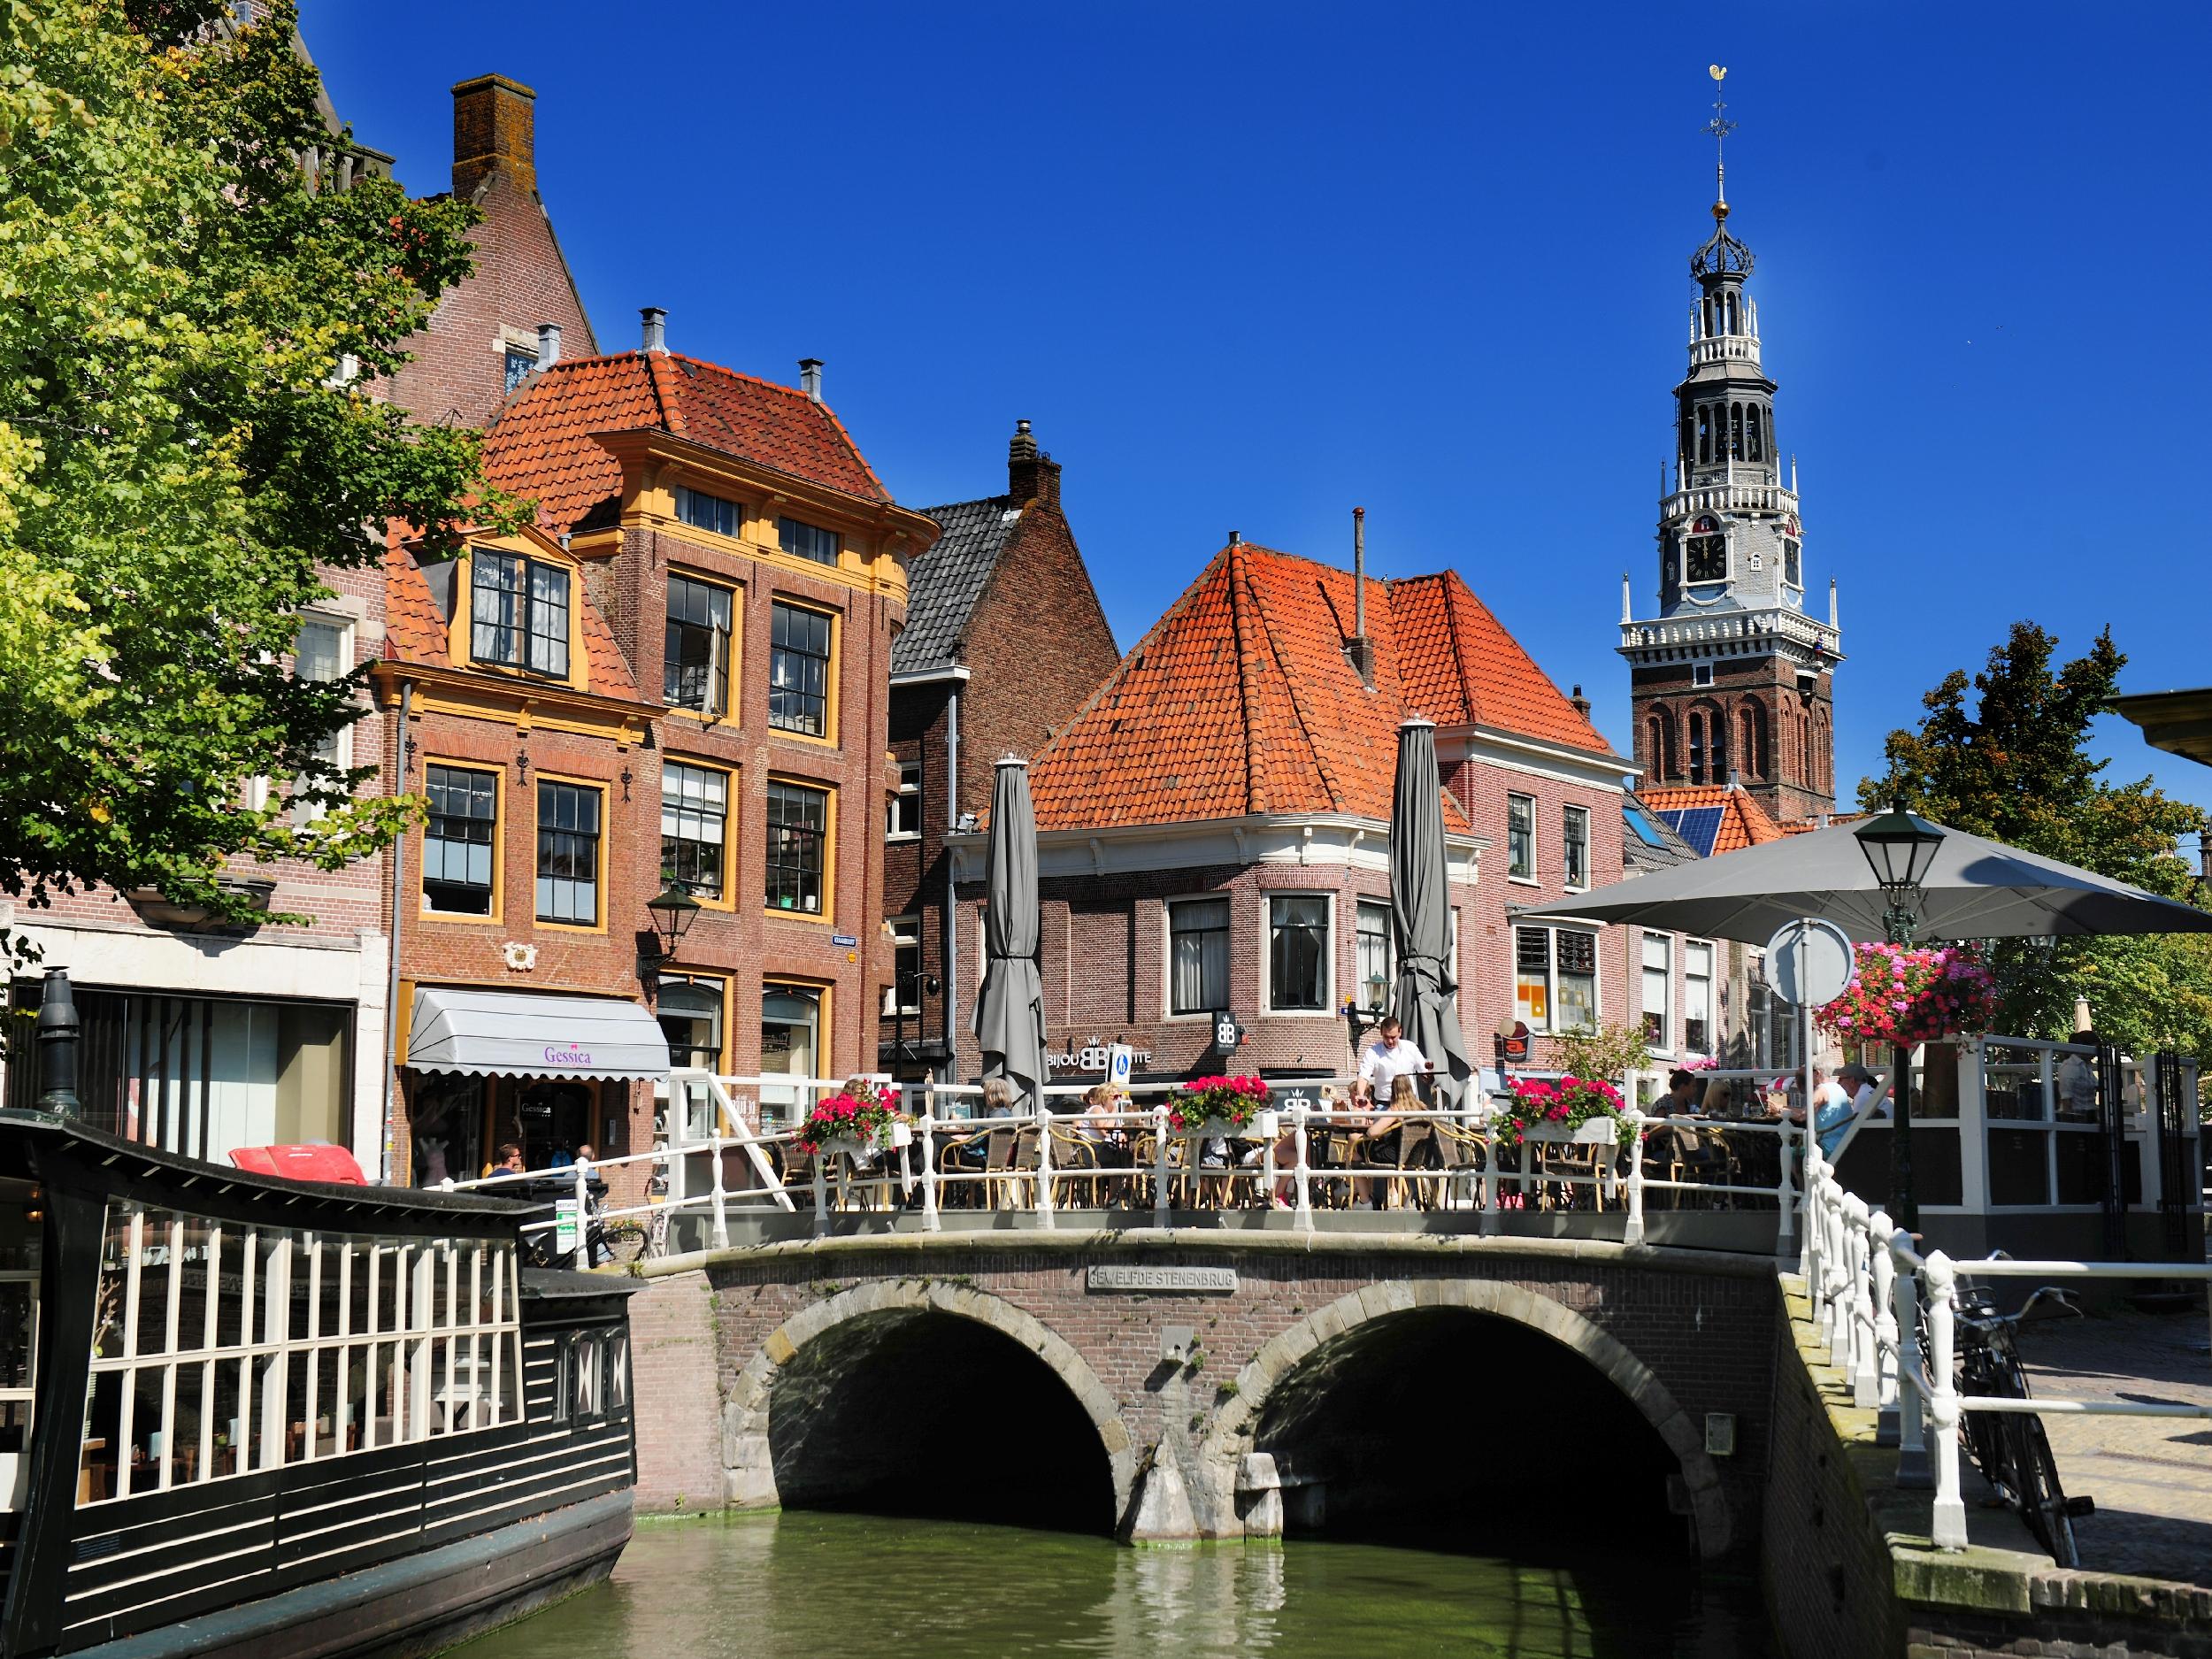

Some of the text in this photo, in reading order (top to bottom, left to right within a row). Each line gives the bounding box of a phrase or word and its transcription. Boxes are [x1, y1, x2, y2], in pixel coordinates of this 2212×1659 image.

[545, 1046, 592, 1064] Gessica
[1048, 1053, 1079, 1068] BIJOU
[1089, 1271, 1233, 1286] GEWELFDE STENENBRUG
